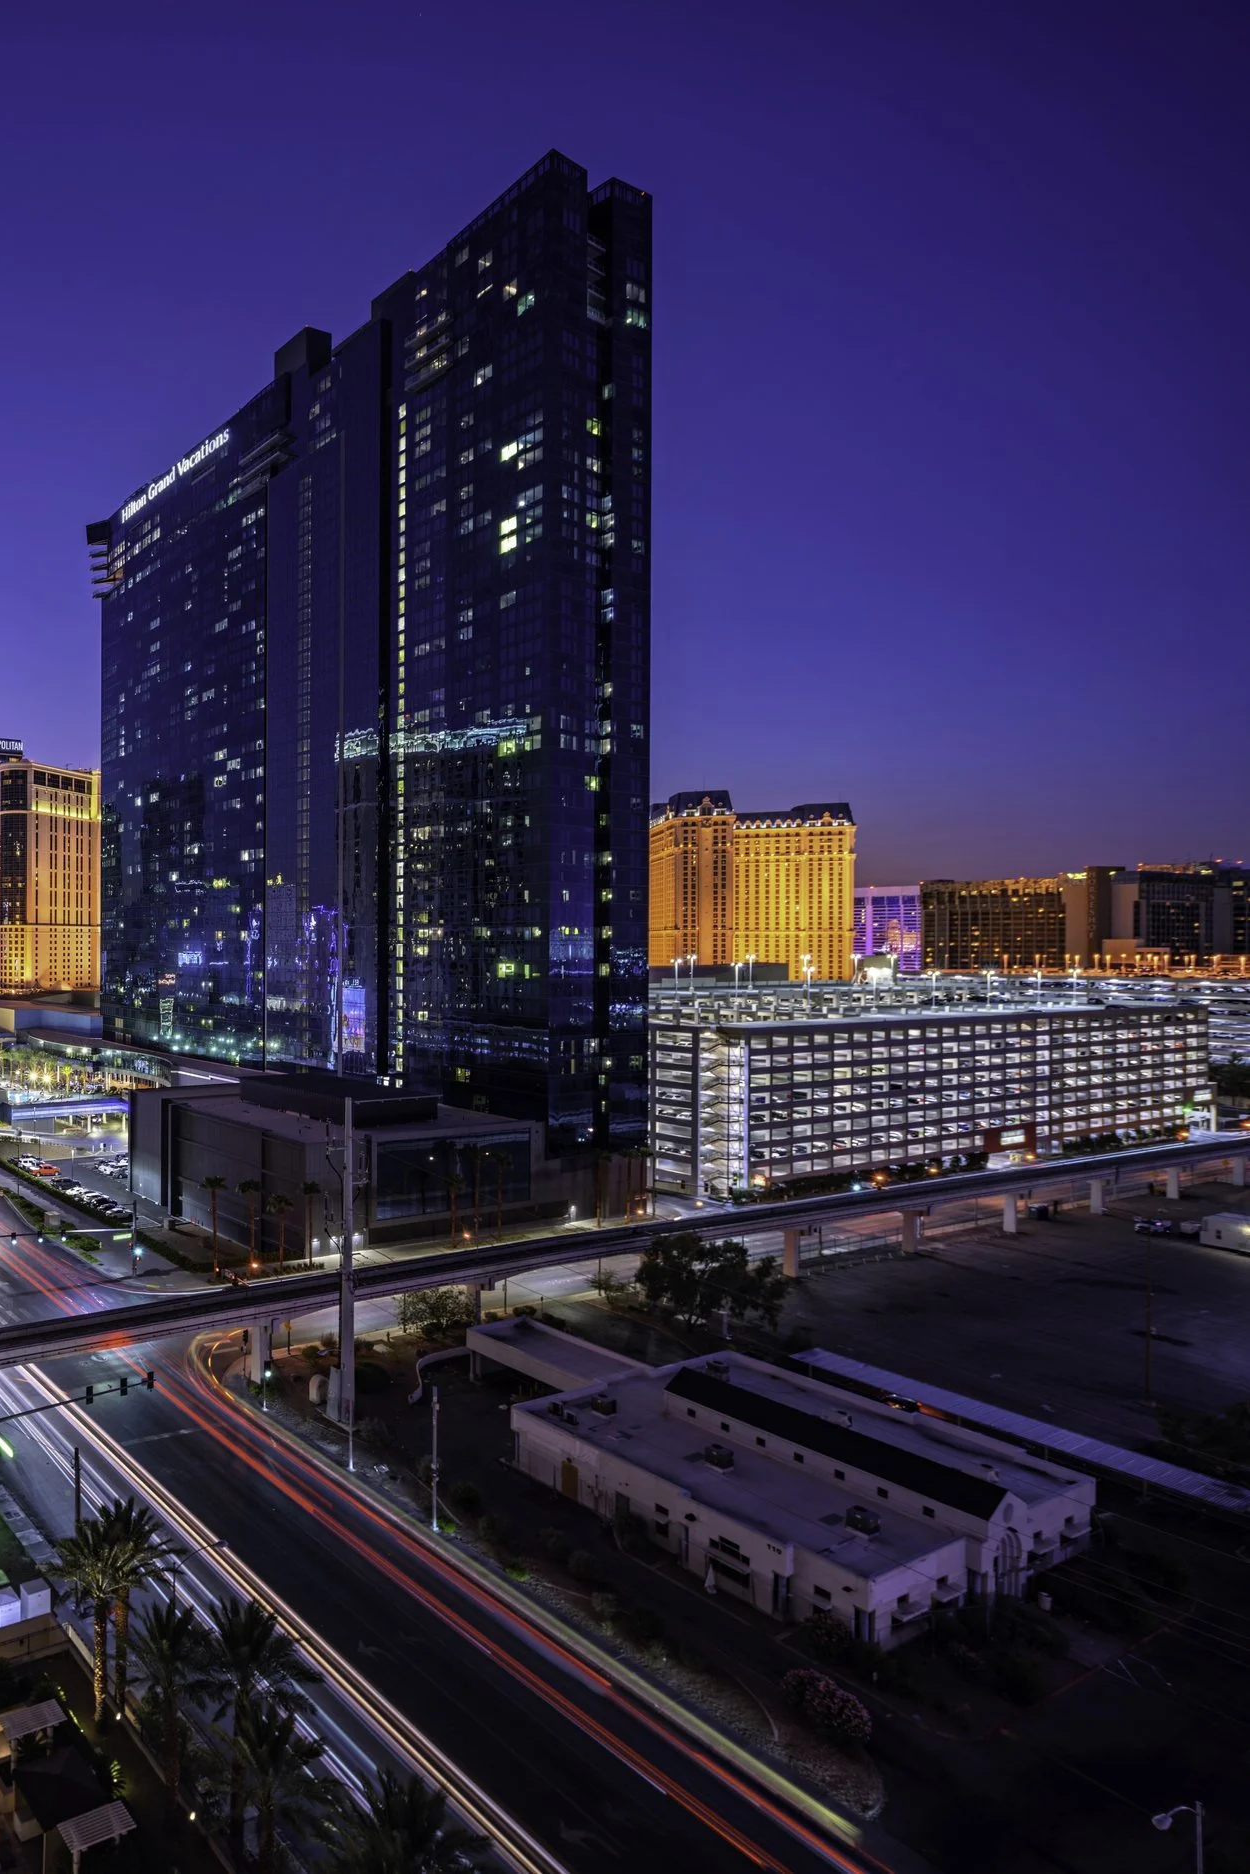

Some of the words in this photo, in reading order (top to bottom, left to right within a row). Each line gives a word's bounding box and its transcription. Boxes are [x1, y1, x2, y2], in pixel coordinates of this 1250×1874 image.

[121, 495, 147, 524] Hilton
[148, 466, 176, 500] Grand
[177, 428, 230, 476] Vacations
